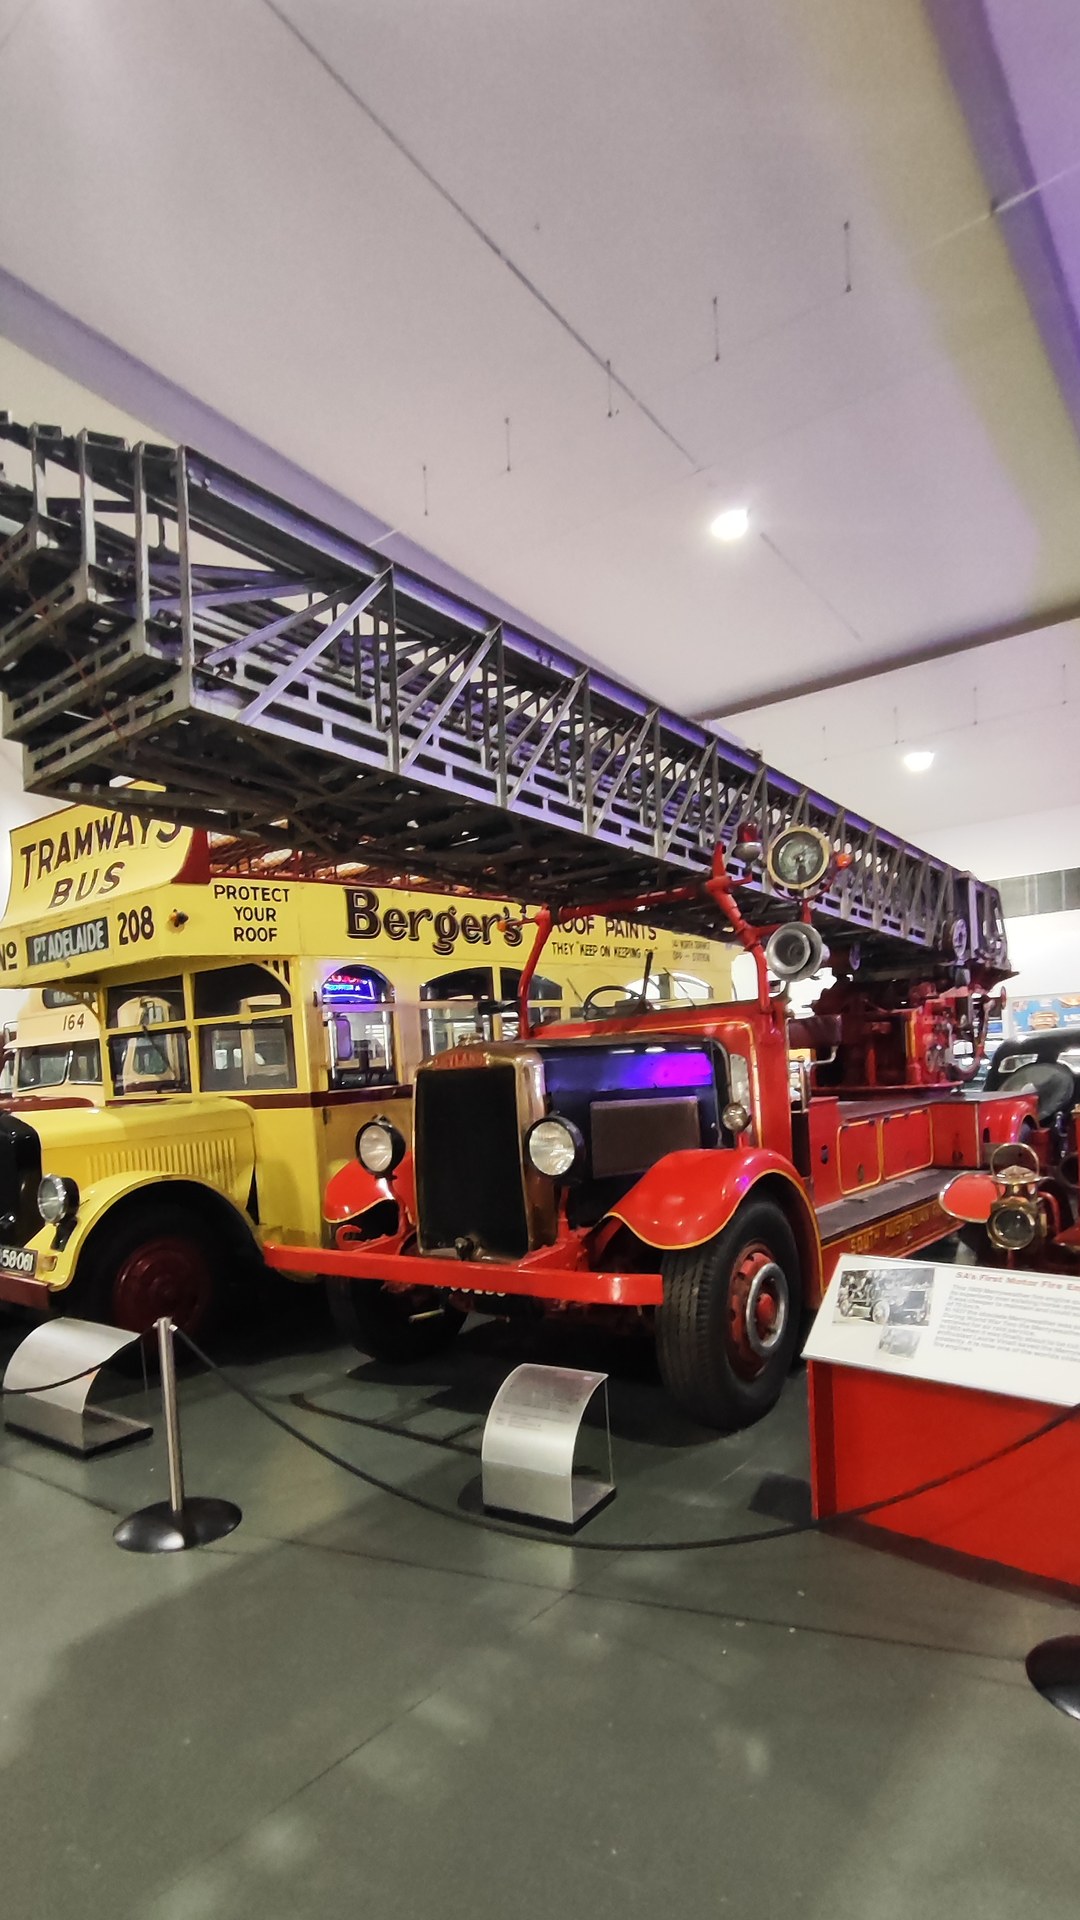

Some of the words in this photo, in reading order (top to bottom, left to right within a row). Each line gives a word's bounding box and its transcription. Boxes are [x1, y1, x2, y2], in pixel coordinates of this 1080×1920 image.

[48, 861, 125, 908] BUS
[214, 884, 290, 902] PROTECT
[233, 906, 276, 922] YOUR
[344, 887, 523, 955] Berger's
[117, 905, 154, 945] 208
[605, 916, 657, 940] PAINTS
[48, 921, 105, 961] ADELAIDE
[233, 927, 277, 942] ROOF
[552, 941, 574, 955] THEY
[600, 945, 610, 957] ON
[63, 1013, 85, 1031] 164
[979, 1274, 1003, 1283] First
[1006, 1276, 1038, 1287] Motor
[1041, 1280, 1063, 1290] Fire
